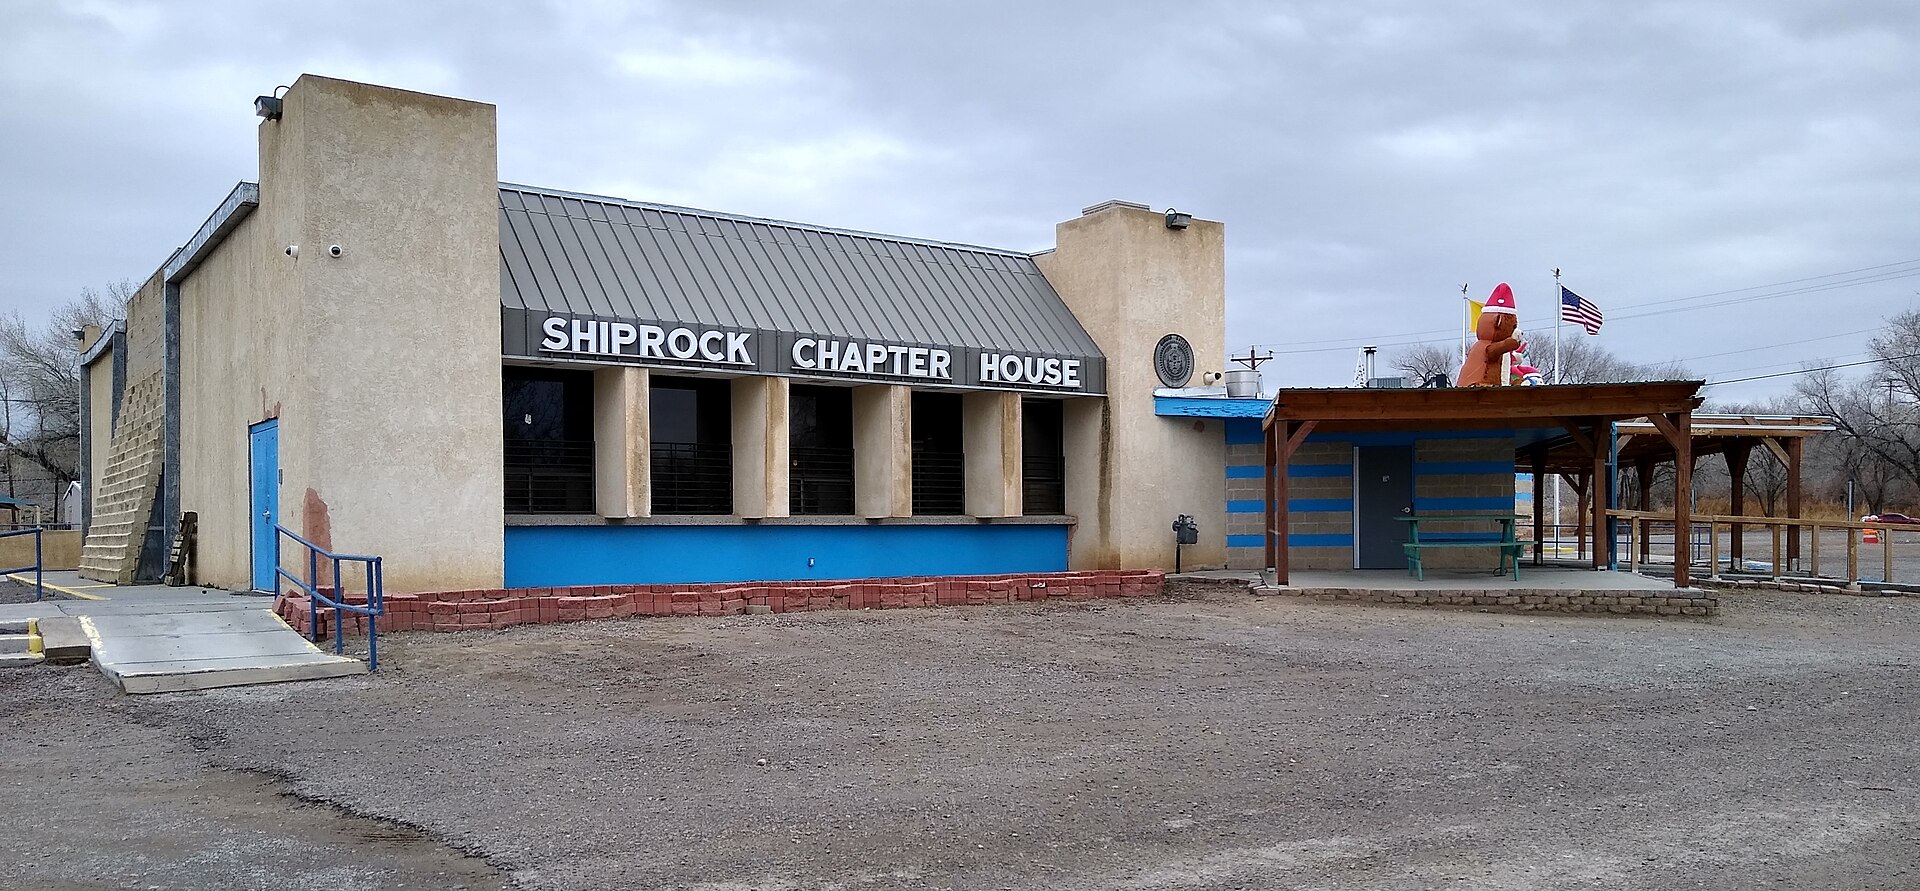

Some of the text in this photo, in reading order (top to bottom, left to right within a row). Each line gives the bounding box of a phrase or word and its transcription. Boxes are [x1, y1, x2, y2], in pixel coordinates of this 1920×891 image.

[541, 317, 1081, 387] SHIPROCK CHAPTER HOUSE
